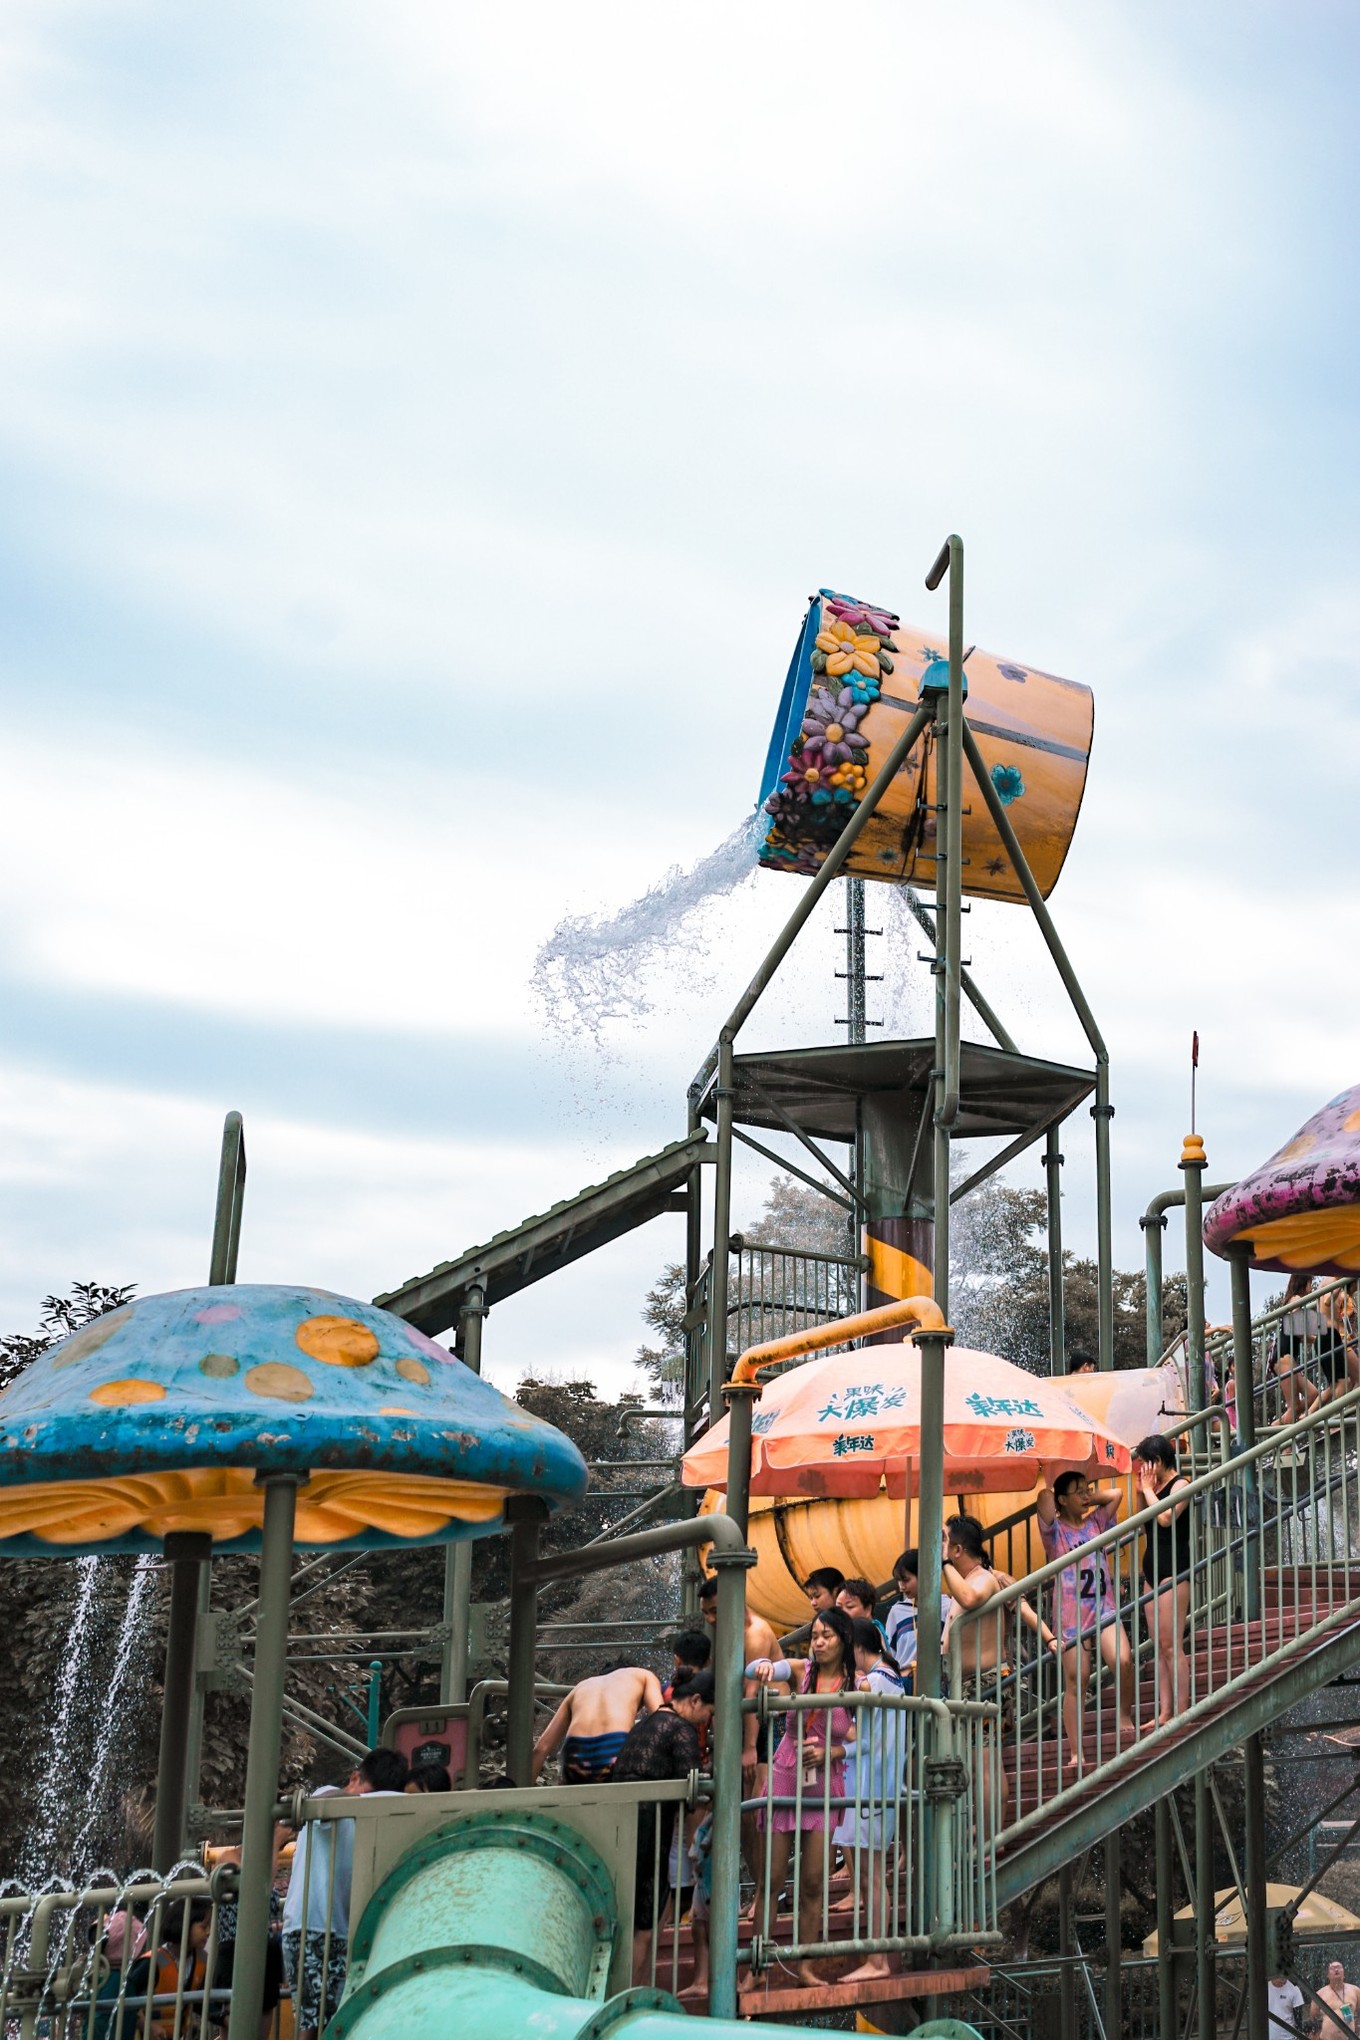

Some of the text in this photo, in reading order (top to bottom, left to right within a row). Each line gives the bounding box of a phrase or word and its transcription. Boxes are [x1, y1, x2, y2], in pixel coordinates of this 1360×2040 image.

[965, 1392, 1044, 1418] 美年达
[833, 1433, 874, 1456] 美年达
